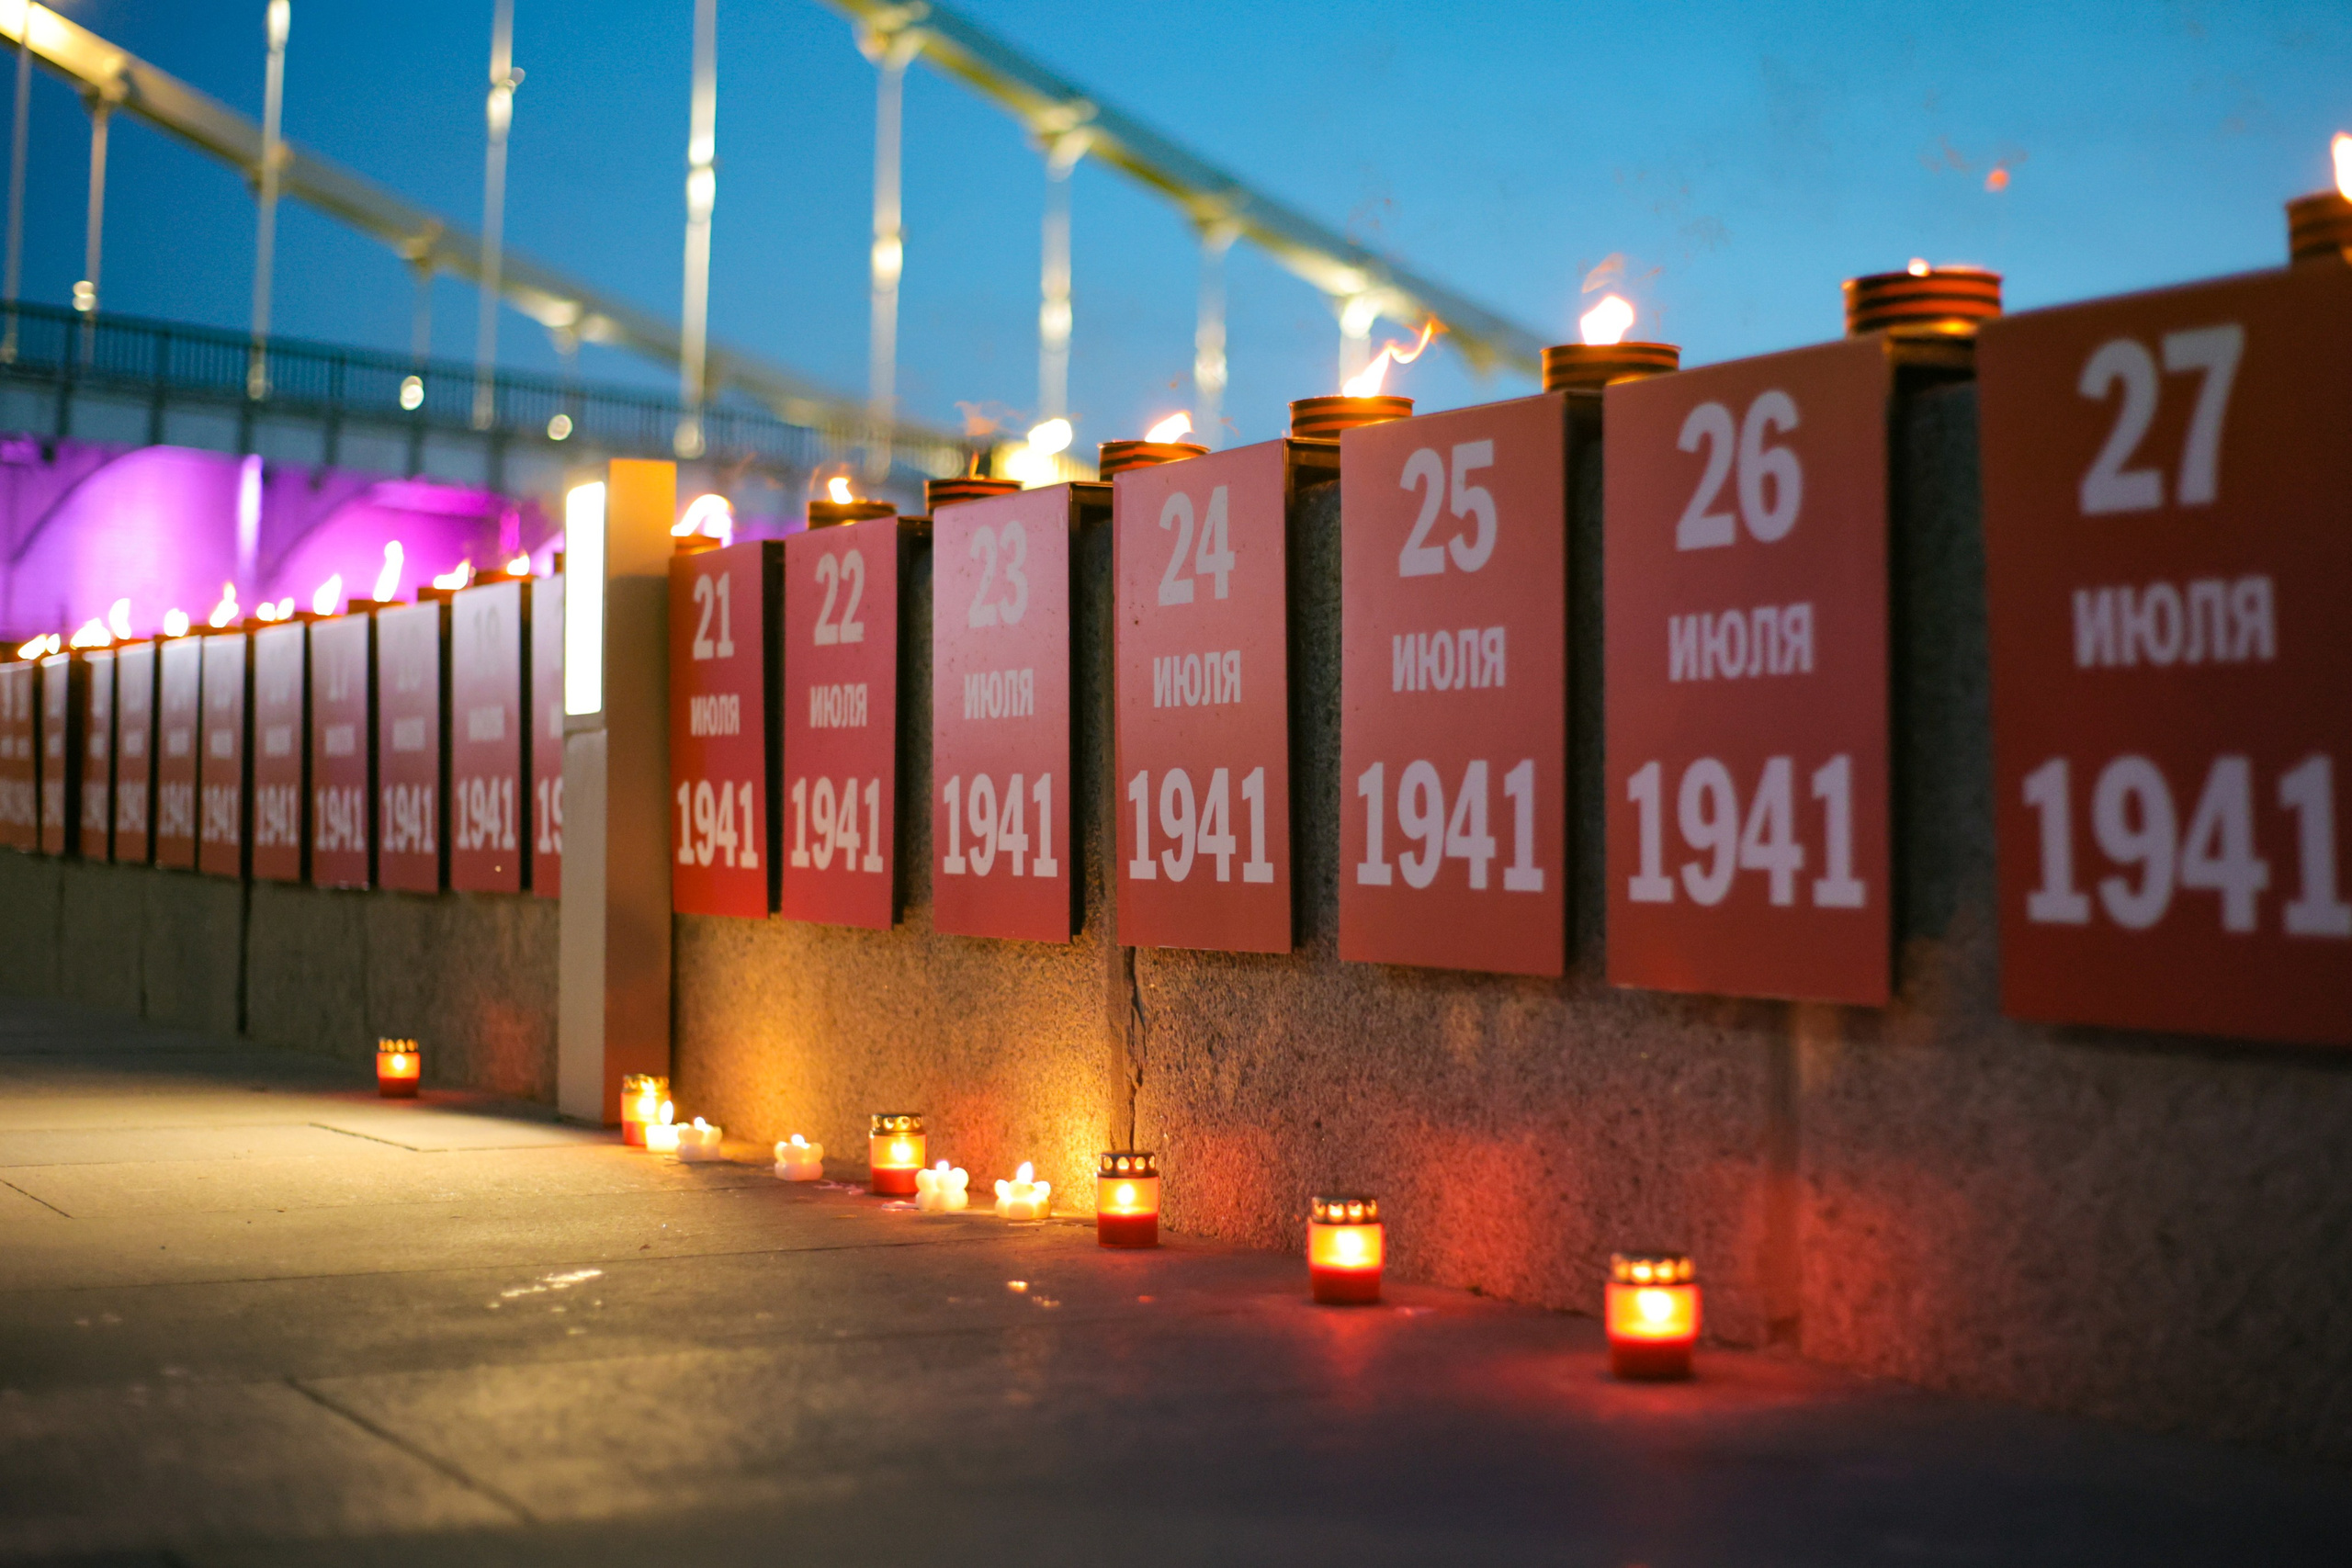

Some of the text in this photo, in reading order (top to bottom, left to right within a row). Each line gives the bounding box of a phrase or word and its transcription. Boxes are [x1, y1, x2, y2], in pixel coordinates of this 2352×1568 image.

[1676, 390, 1804, 551] 26
[2077, 323, 2245, 515] 27
[1158, 485, 1235, 606] 24
[1398, 439, 1498, 578] 25
[693, 572, 734, 660] 21
[814, 549, 865, 646] 22
[968, 520, 1028, 628] 23
[316, 785, 365, 852] 1941
[383, 784, 435, 853] 1941
[458, 776, 515, 851] 1941
[537, 776, 562, 853] 19
[677, 780, 758, 869] 1941
[791, 777, 883, 873] 1941
[944, 773, 1057, 877] 1941
[1128, 767, 1273, 884] 1941
[1357, 759, 1544, 892] 1941
[1626, 755, 1865, 908] 1941
[2021, 753, 2352, 937] 1941
